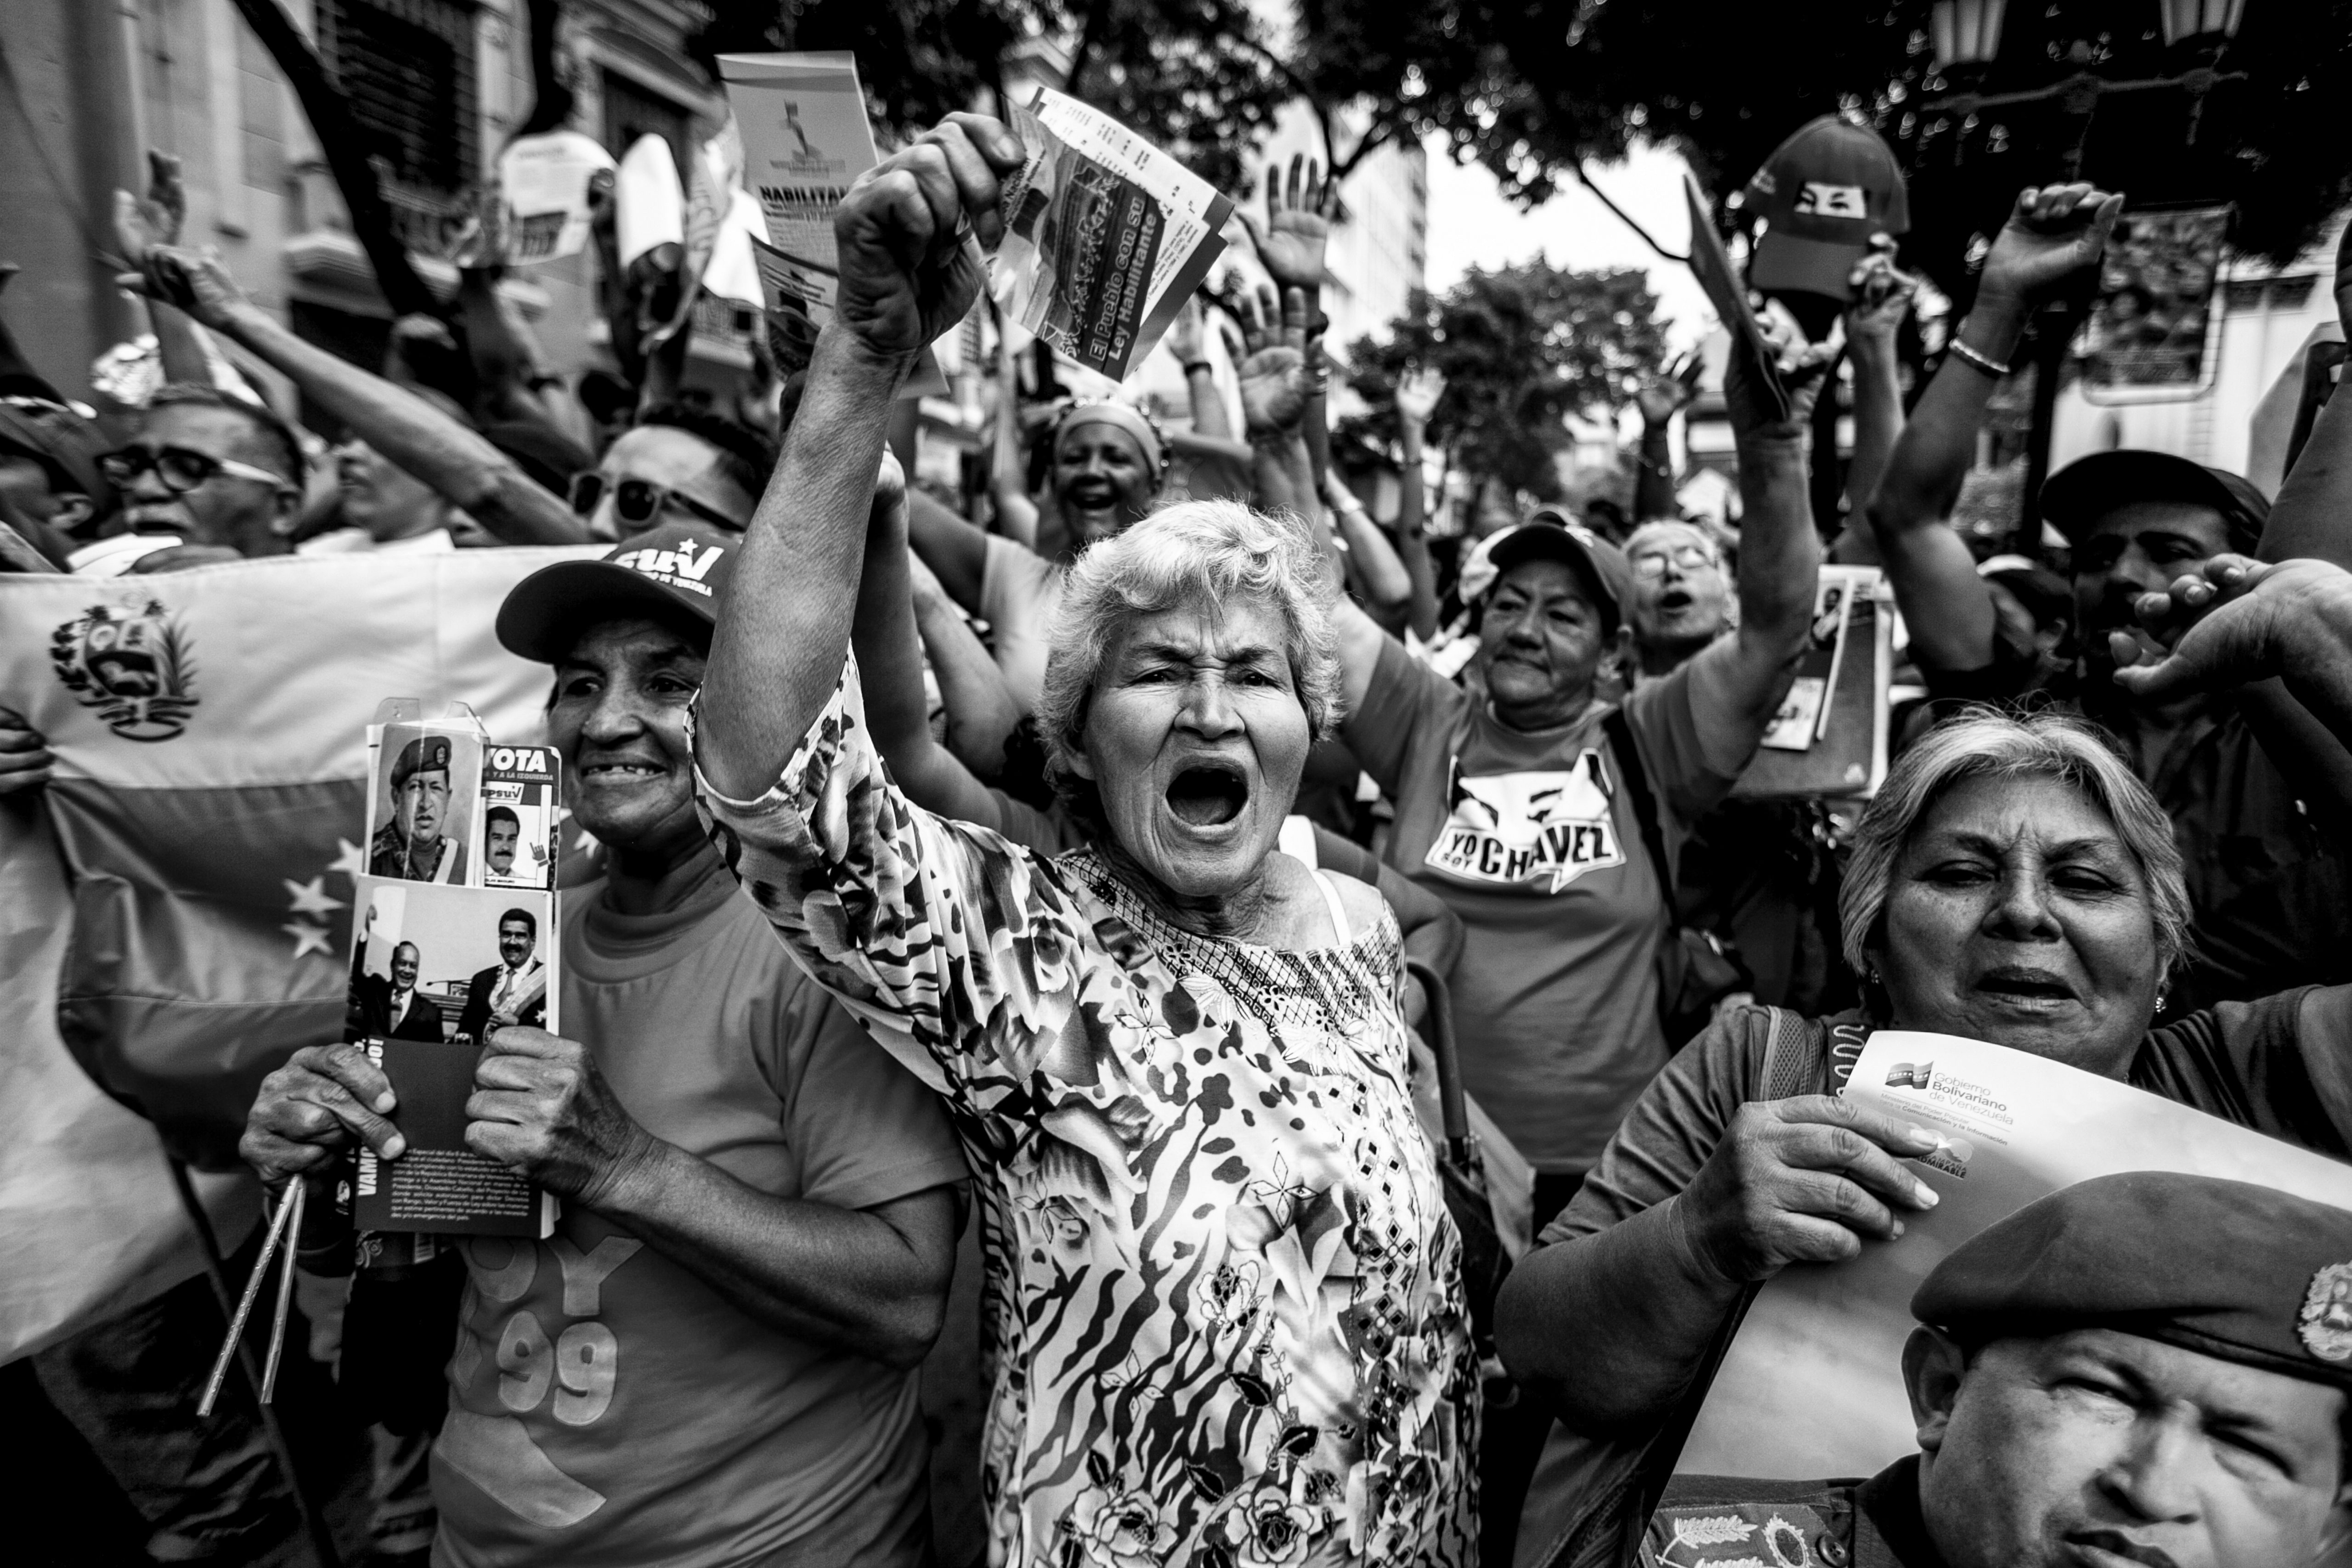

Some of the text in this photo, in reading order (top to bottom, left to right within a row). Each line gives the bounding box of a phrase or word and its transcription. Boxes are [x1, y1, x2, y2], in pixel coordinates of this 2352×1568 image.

[1089, 196, 1146, 361] El Pueblo con su
[1108, 213, 1157, 361] Ley Habilitante
[1452, 833, 1477, 856] YO
[1479, 826, 1611, 878] CHAVEZ
[1441, 853, 1474, 872] SOY
[1932, 1081, 2007, 1111] Bolivariano
[1934, 1072, 1991, 1096] Gobierno
[1880, 1093, 1911, 1106] Ministerio
[1923, 1105, 1943, 1115] Poder
[1944, 1112, 1970, 1124] Popular
[1929, 1092, 2013, 1125] de Venezuela
[1902, 1105, 1951, 1125] Comunicación
[1967, 1126, 2008, 1146] Información
[358, 1146, 378, 1196] VAMO
[1927, 1154, 1966, 1172] AMPAÑA
